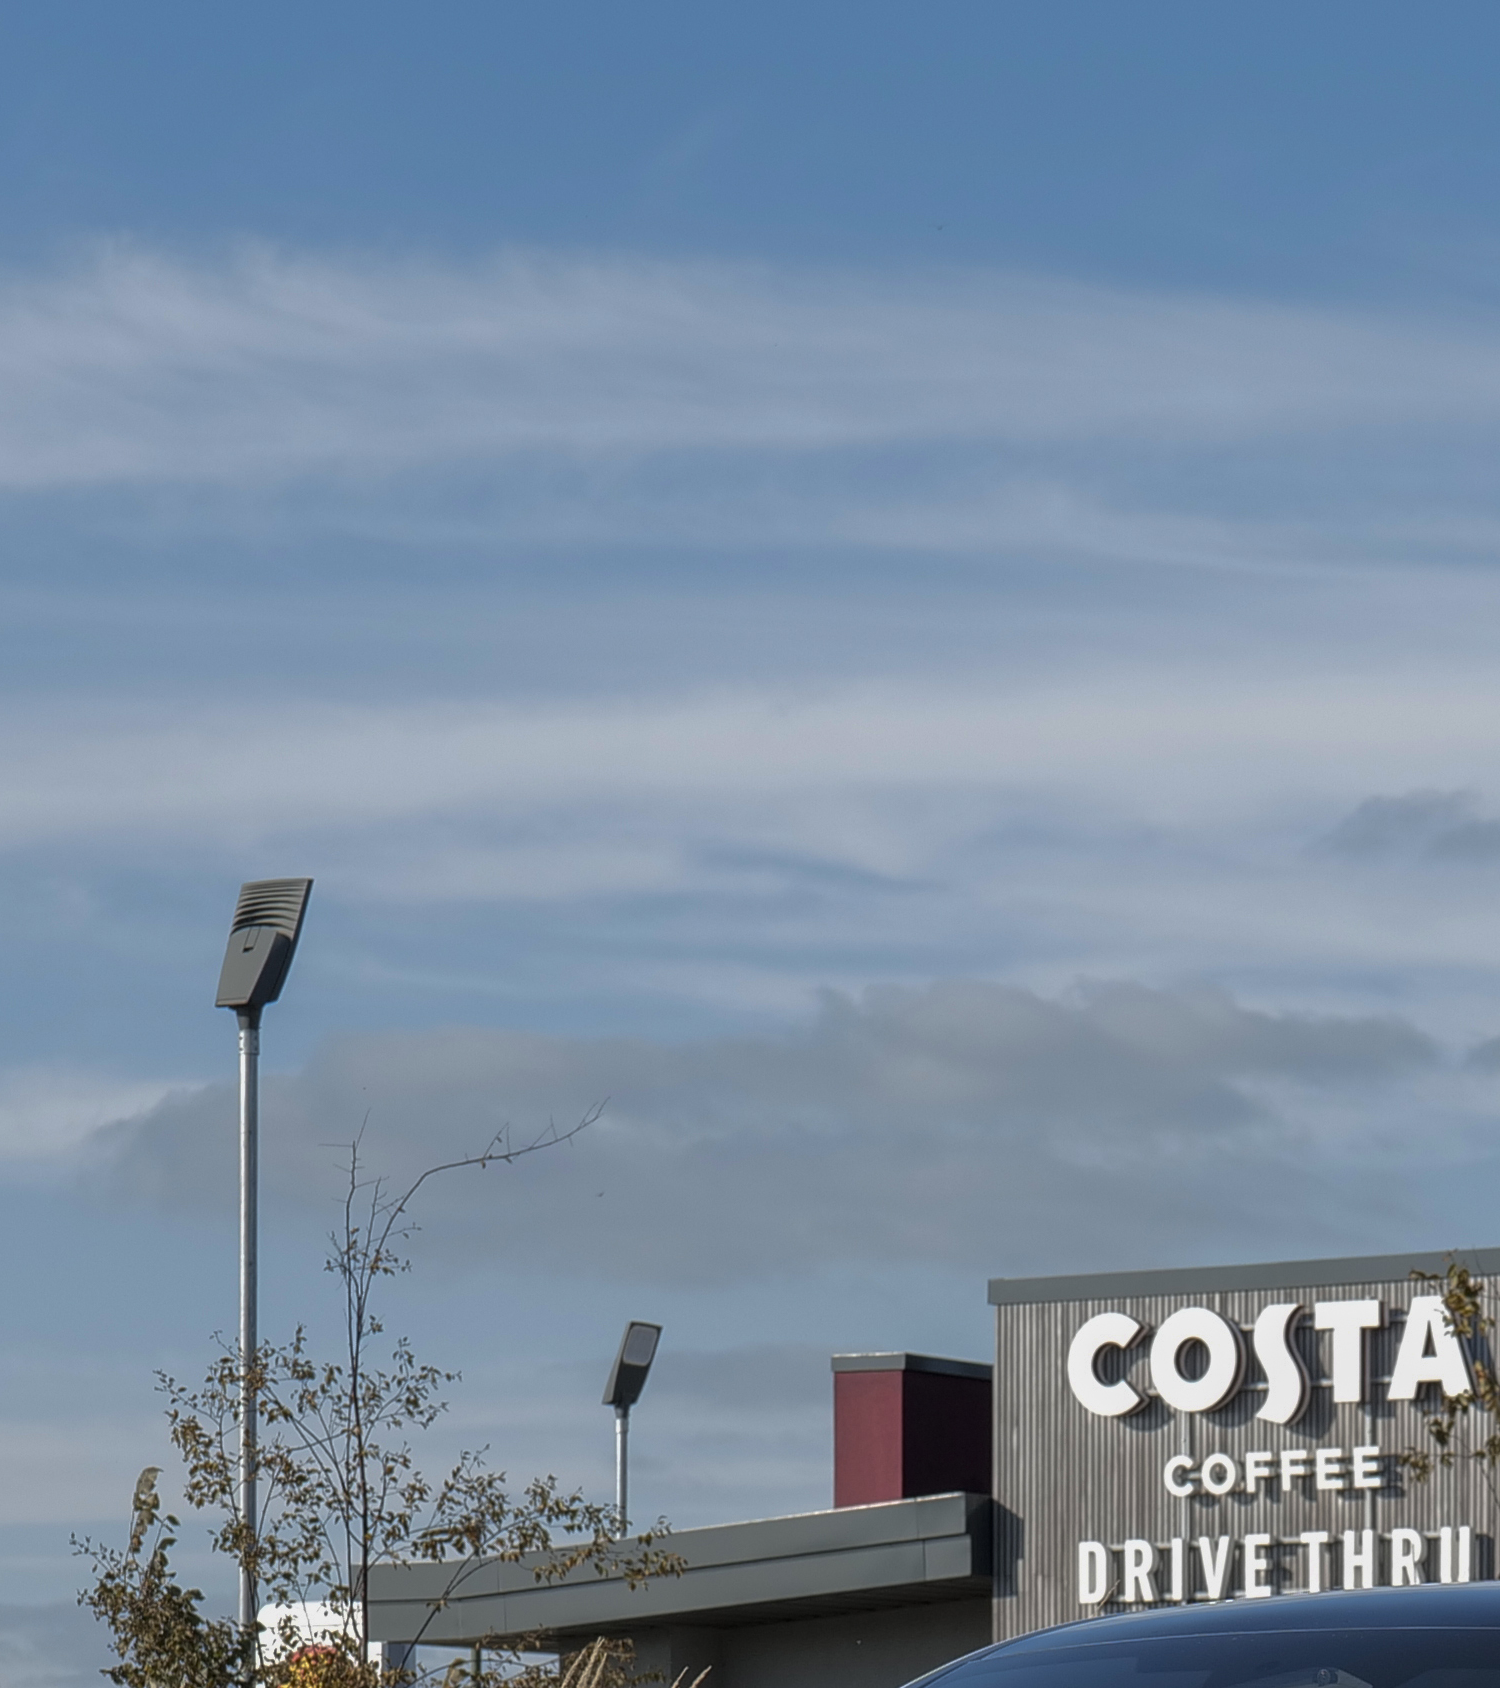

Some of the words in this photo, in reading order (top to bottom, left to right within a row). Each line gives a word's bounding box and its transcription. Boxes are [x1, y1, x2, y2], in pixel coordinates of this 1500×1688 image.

[1067, 1295, 1474, 1425] COSTA
[1164, 1446, 1382, 1497] COFFEE
[1078, 1533, 1271, 1605] DRIVE
[1300, 1526, 1471, 1594] THRU
